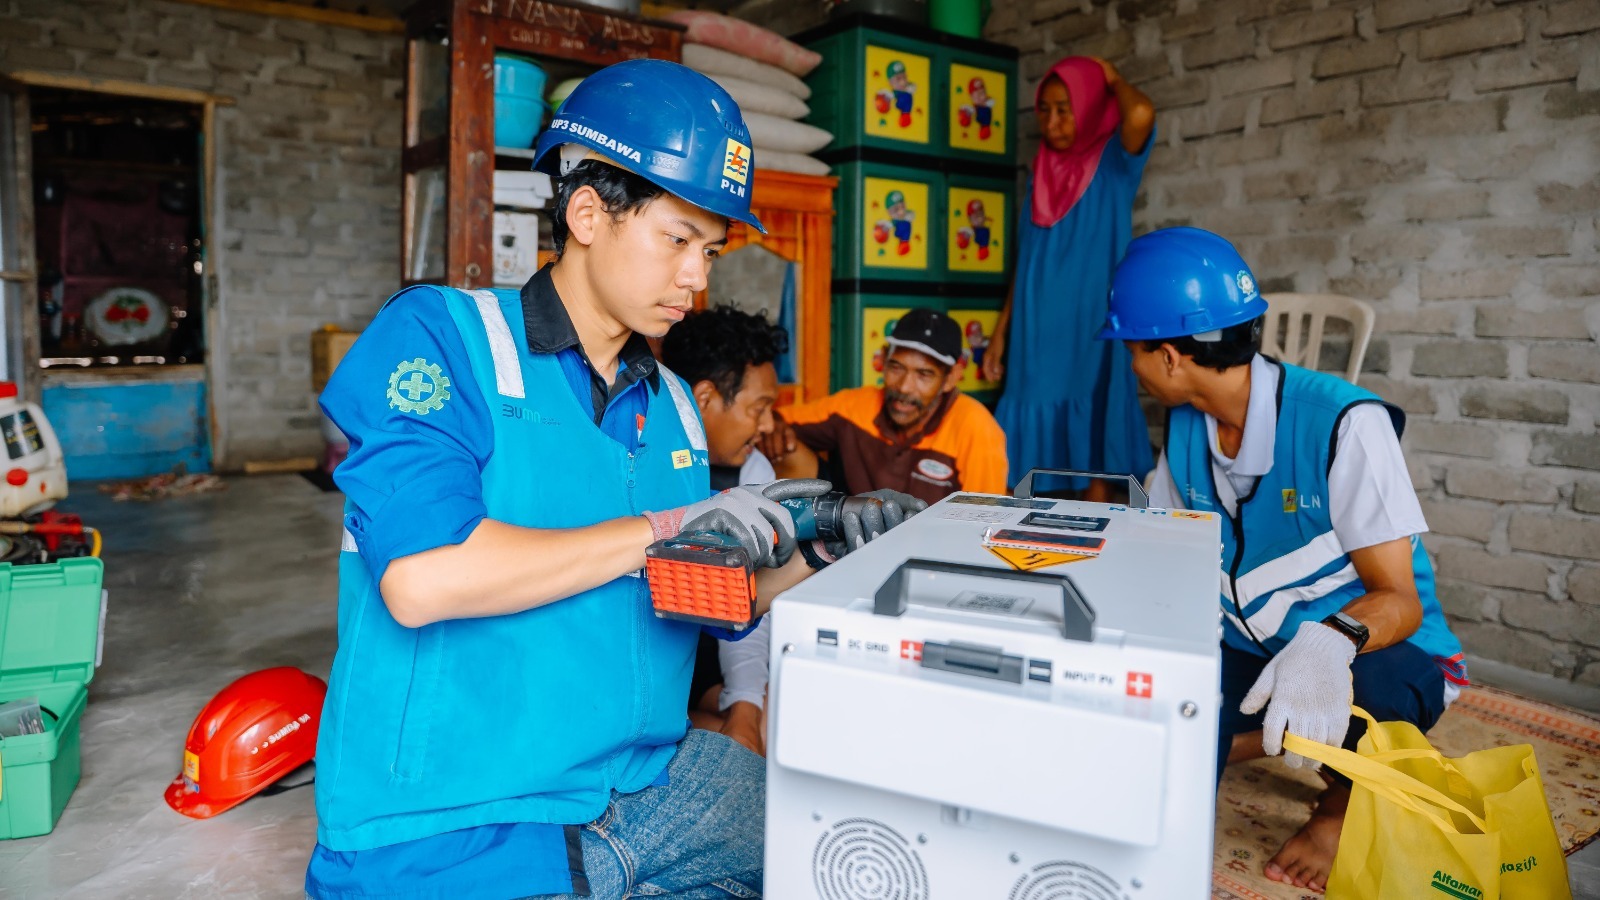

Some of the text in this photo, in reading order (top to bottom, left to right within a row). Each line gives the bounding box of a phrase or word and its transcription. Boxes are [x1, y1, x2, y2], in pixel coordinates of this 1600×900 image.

[551, 119, 569, 130] UP3
[568, 122, 642, 164] SUMBAWA
[720, 178, 746, 198] PLN
[1296, 493, 1321, 509] LN
